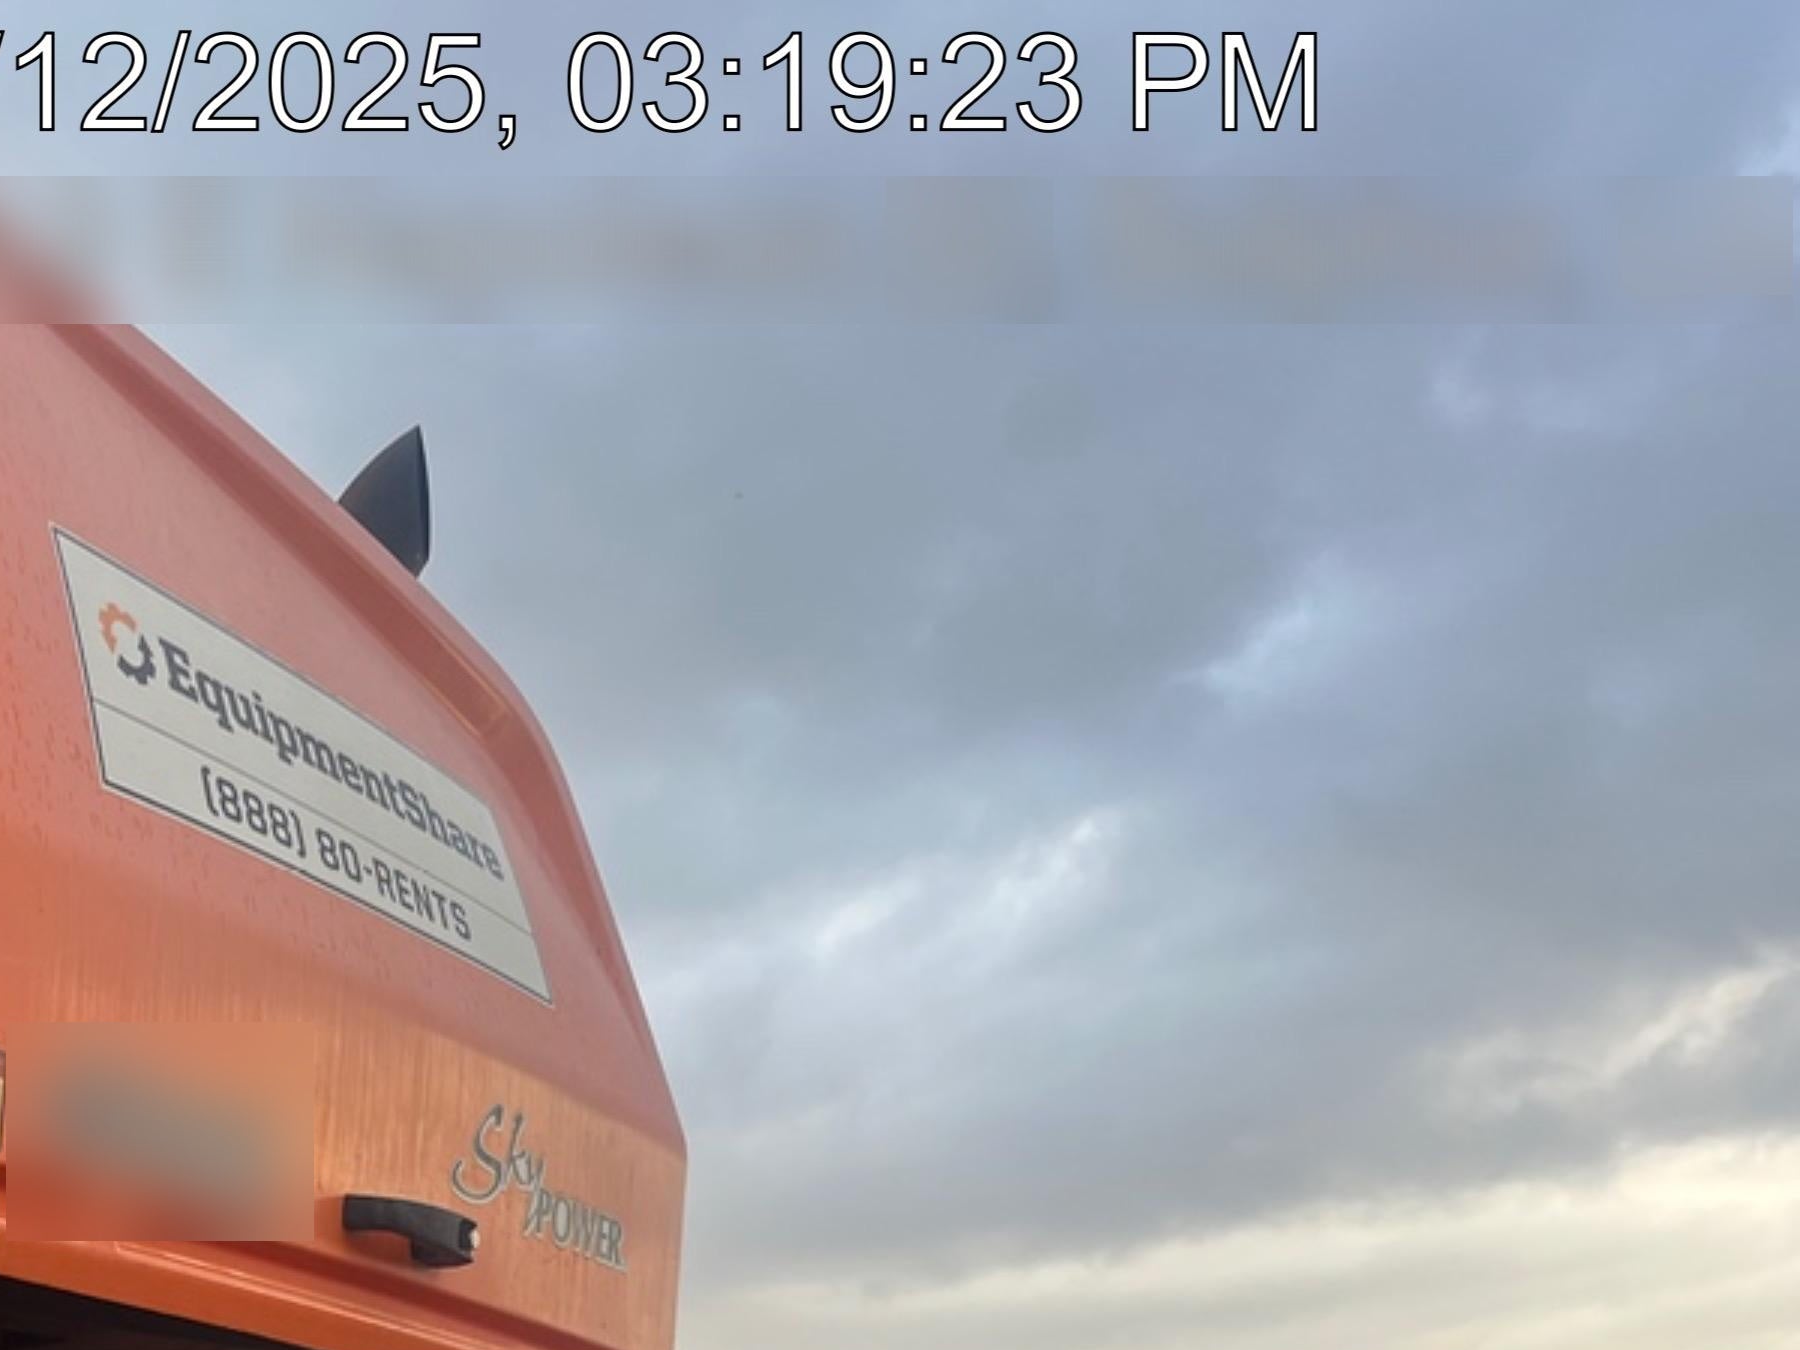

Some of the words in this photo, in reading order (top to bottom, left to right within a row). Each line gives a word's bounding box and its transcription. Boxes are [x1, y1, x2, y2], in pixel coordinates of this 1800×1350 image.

[157, 636, 504, 881] EquipmentShare
[200, 766, 308, 859] (888)
[315, 826, 472, 942] 80-RENTS
[452, 1103, 544, 1237] Sky
[532, 1187, 628, 1273] POWER
